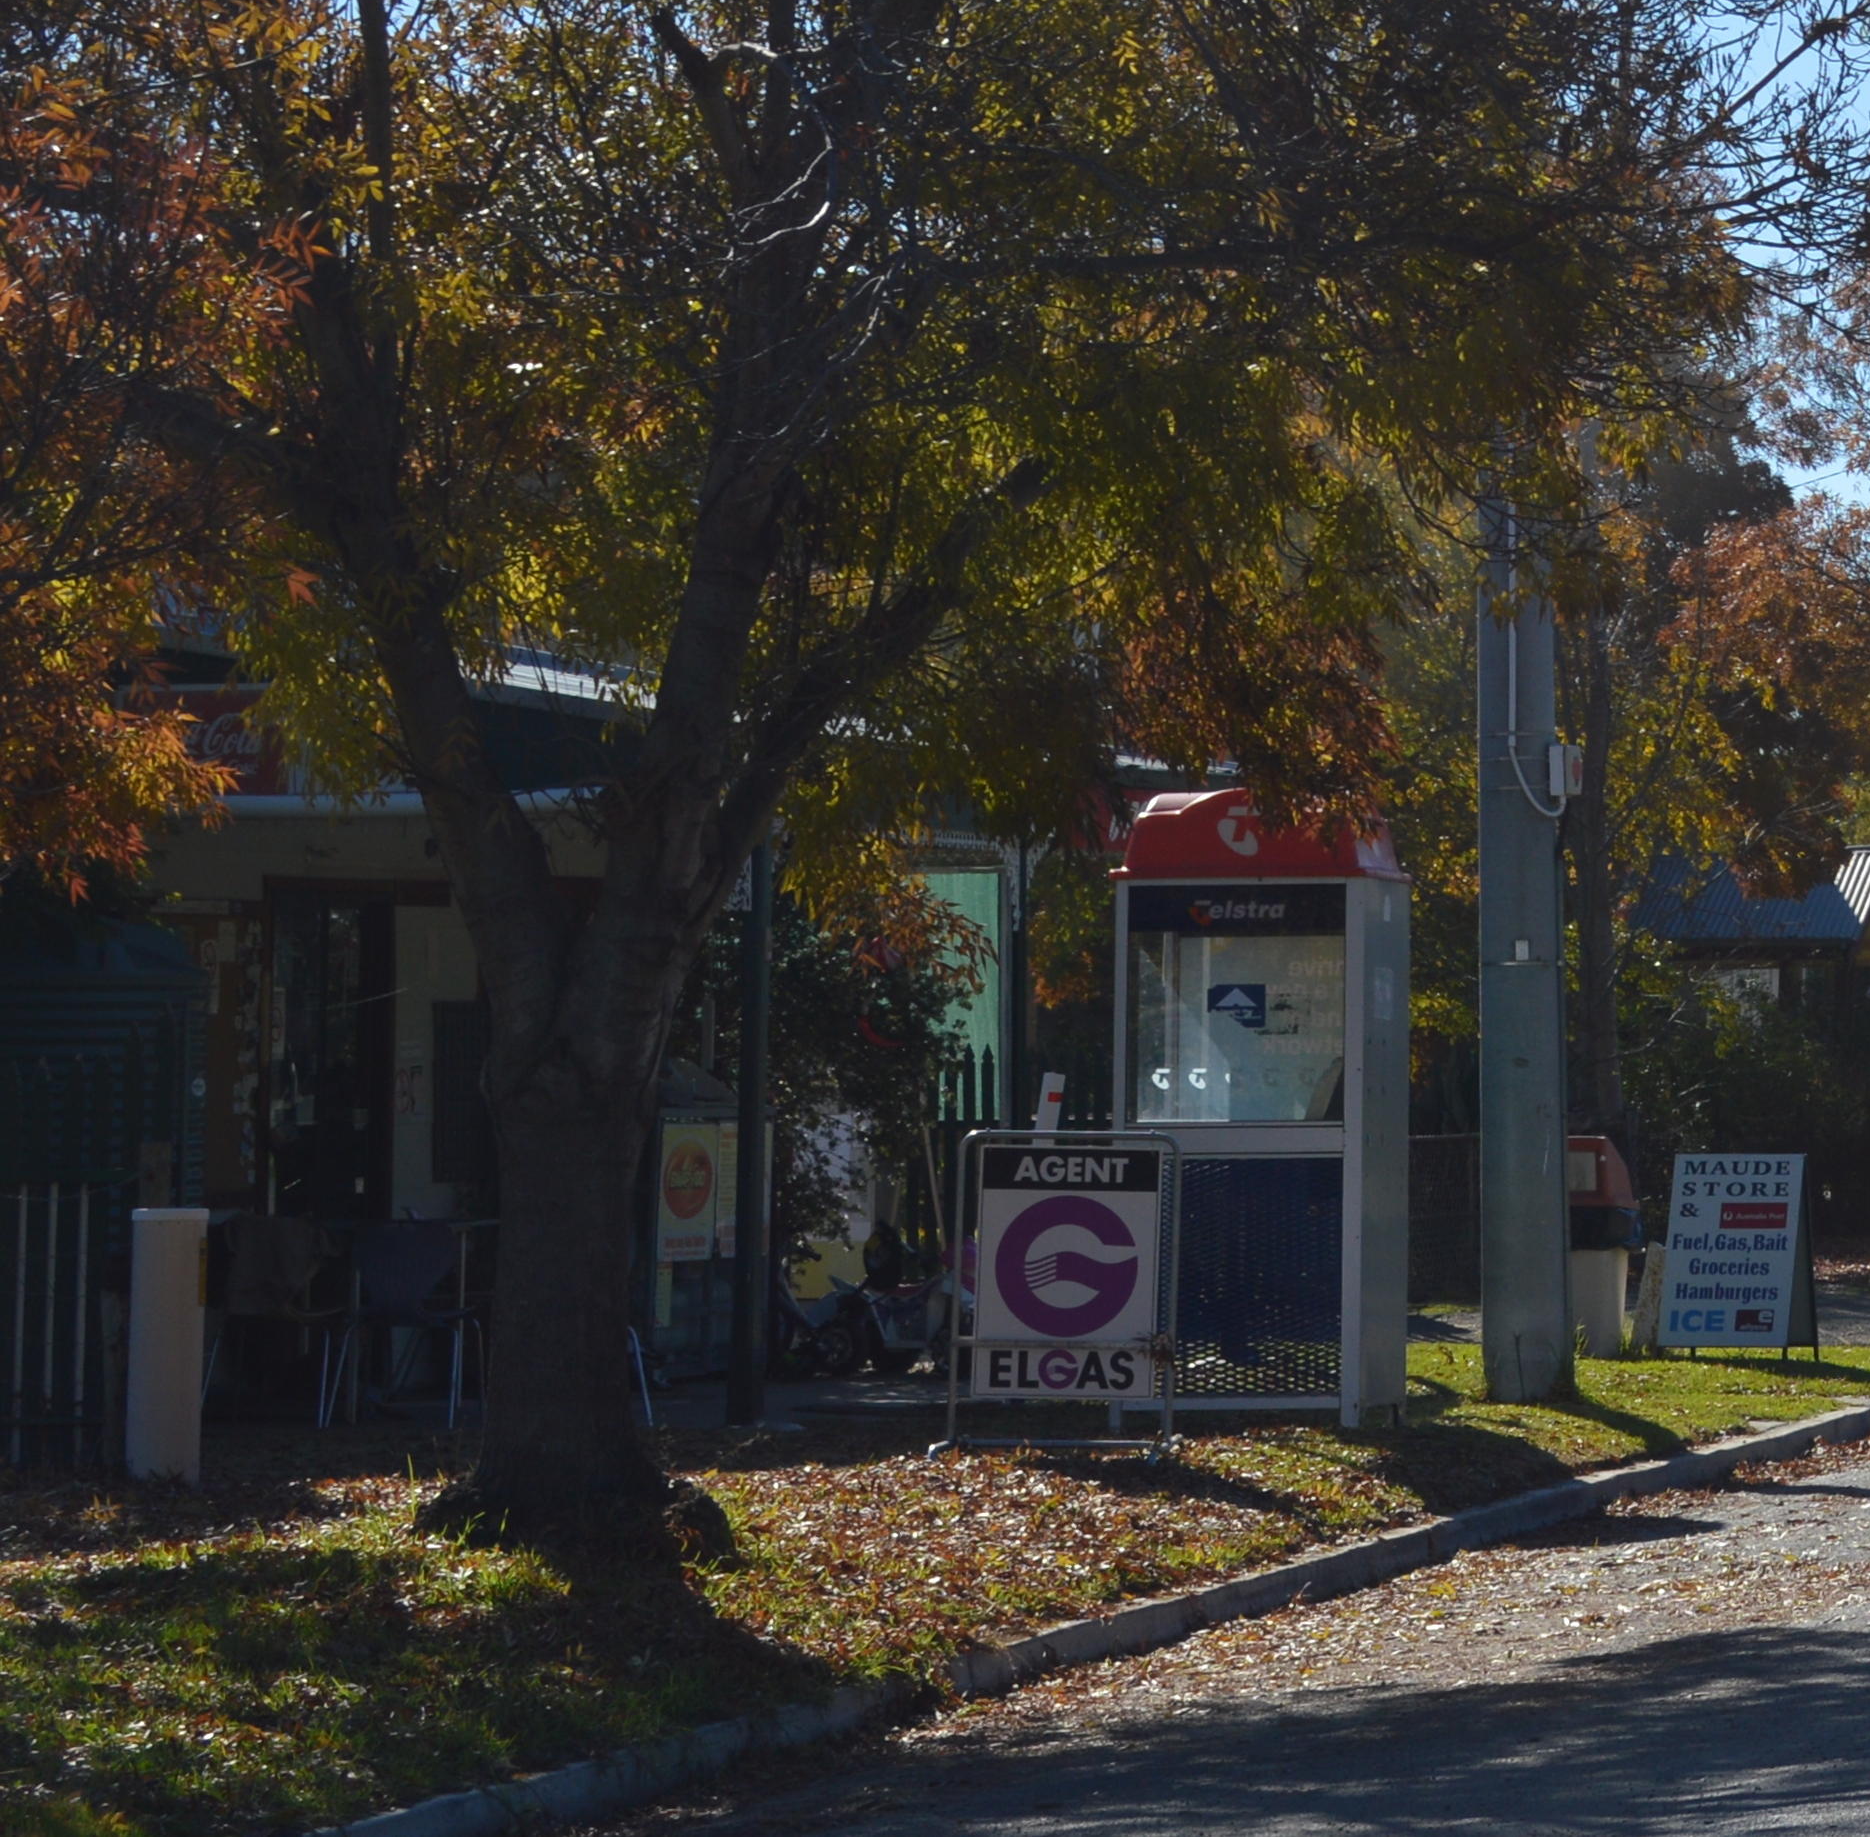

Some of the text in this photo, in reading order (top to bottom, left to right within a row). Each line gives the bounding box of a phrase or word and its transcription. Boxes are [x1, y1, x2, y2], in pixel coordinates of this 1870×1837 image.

[1014, 1155, 1130, 1184] AGENT
[1683, 1160, 1791, 1176] MAUDE
[1681, 1182, 1790, 1197] STORE
[1680, 1203, 1700, 1218] &
[1689, 1258, 1770, 1276] Groceries
[1675, 1282, 1778, 1303] Hamburgers
[1669, 1309, 1726, 1332] ICE
[989, 1350, 1136, 1391] ELGAS
